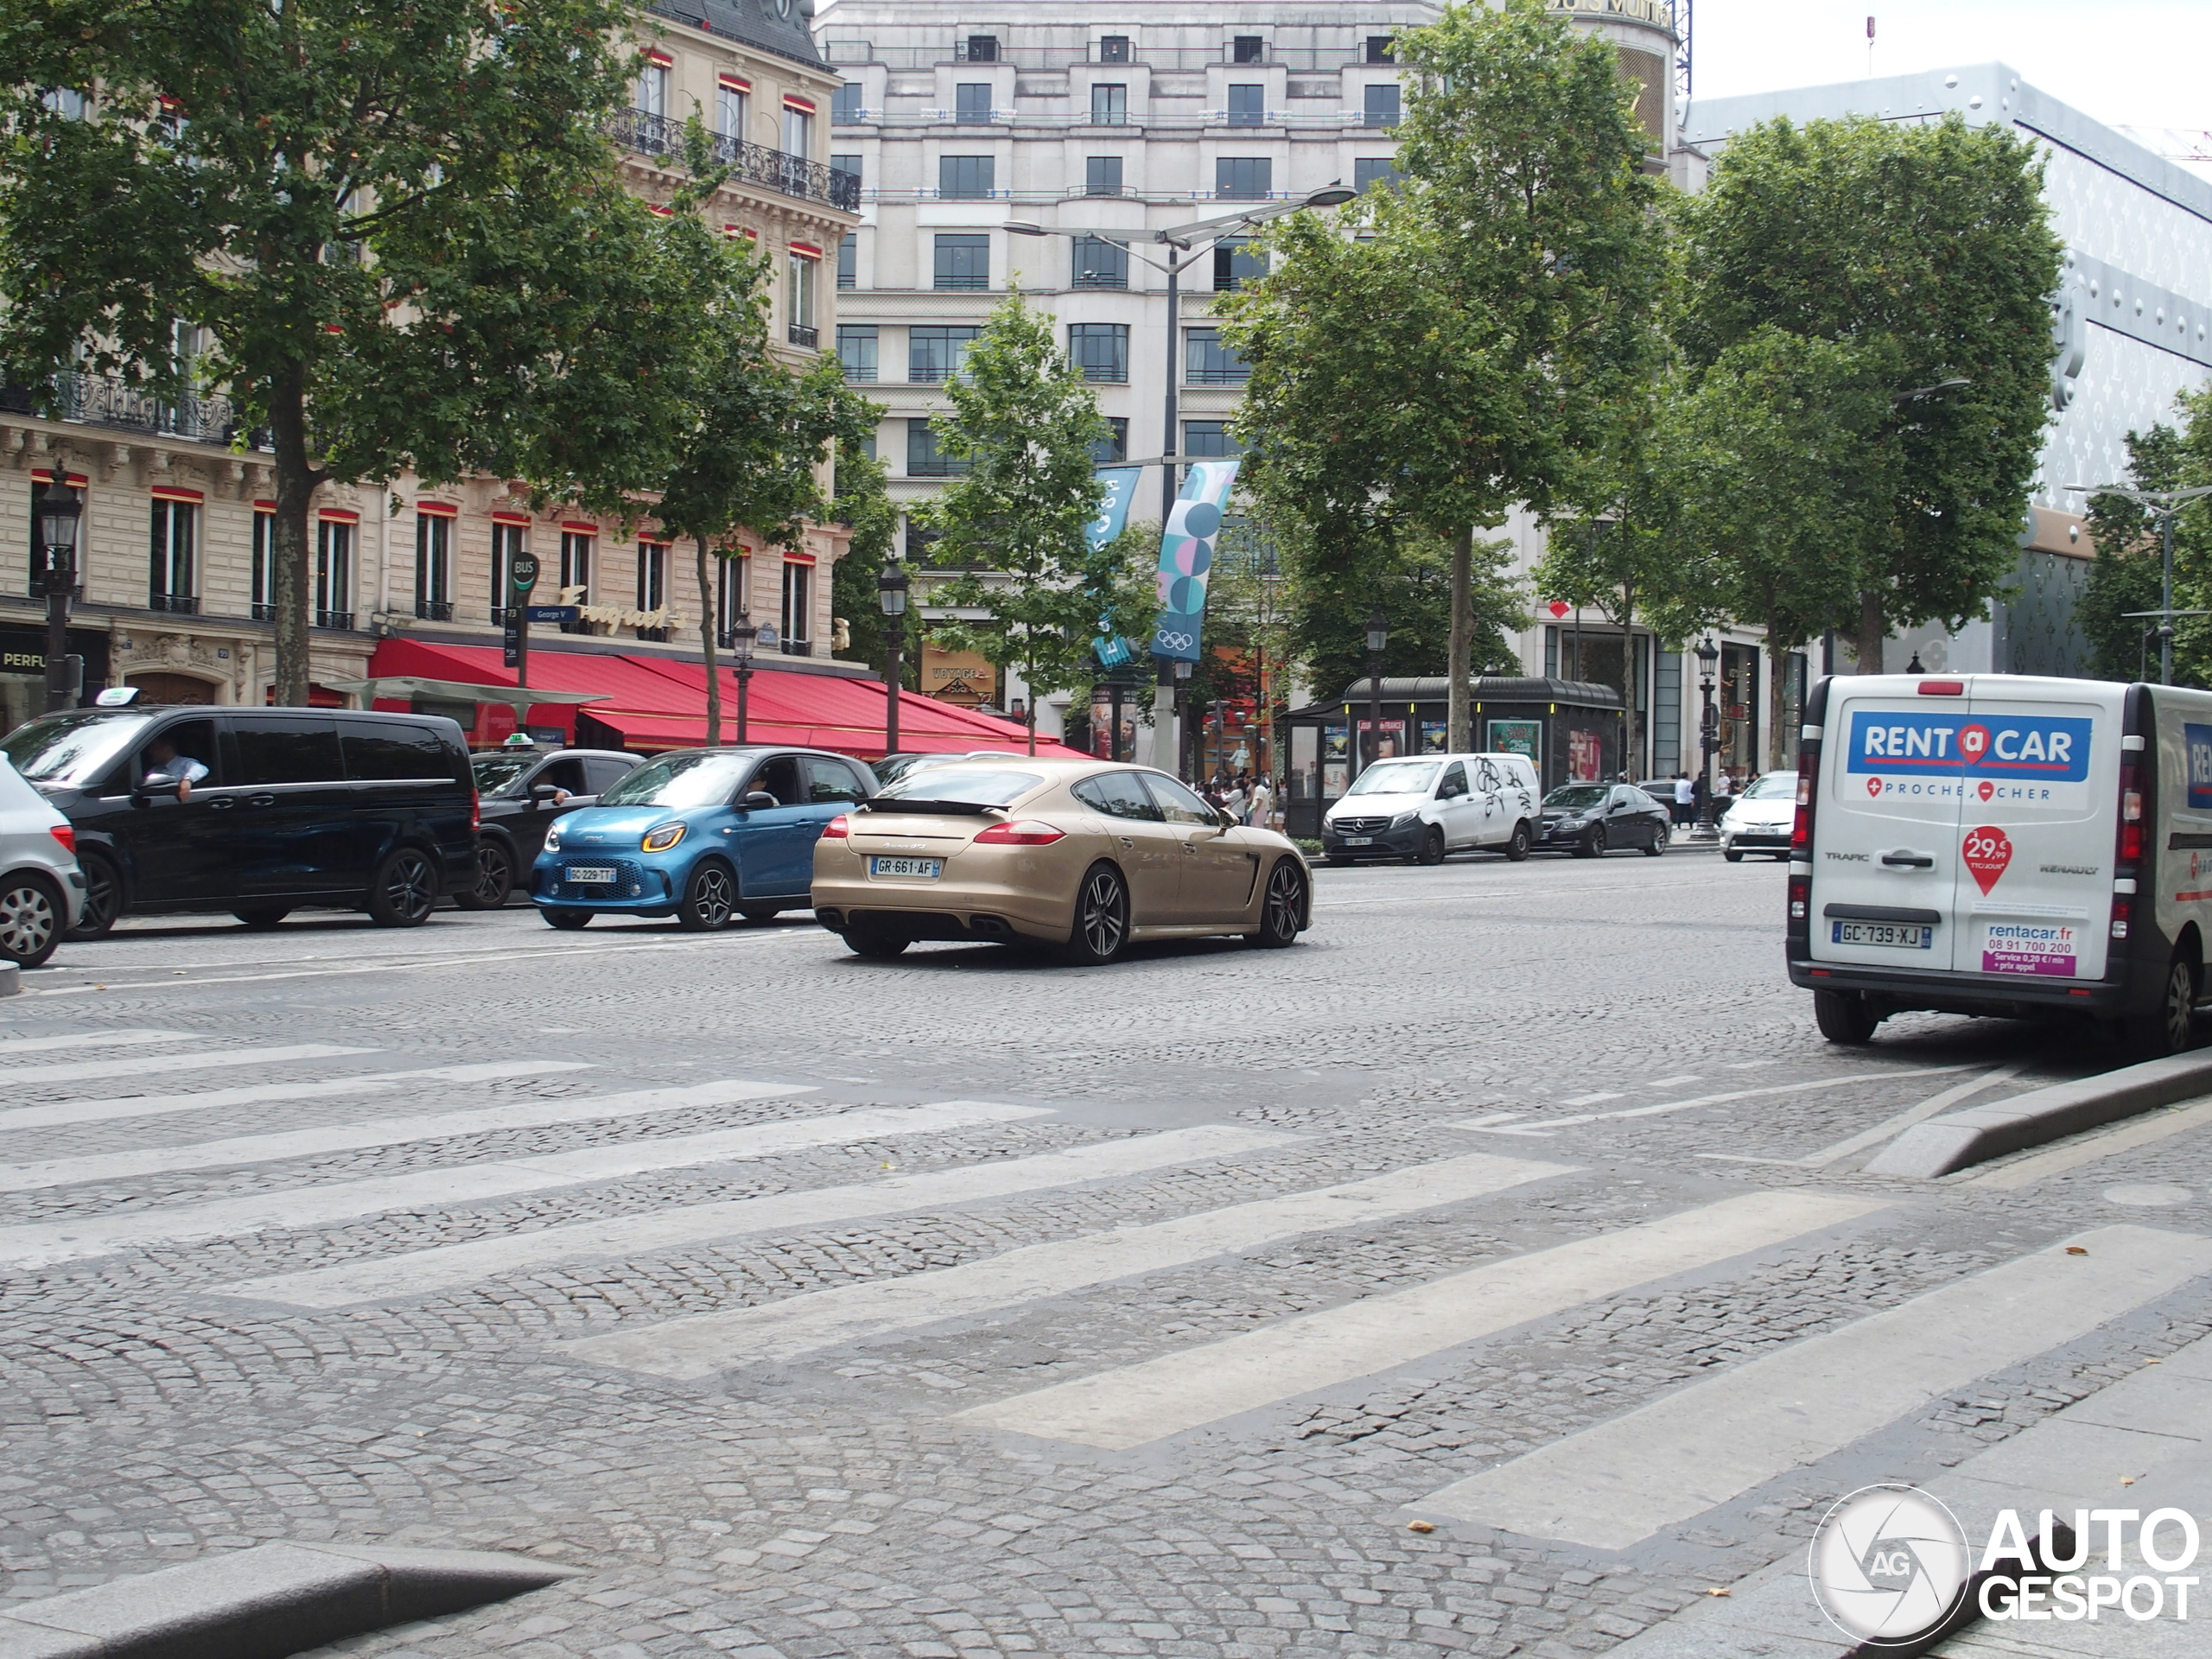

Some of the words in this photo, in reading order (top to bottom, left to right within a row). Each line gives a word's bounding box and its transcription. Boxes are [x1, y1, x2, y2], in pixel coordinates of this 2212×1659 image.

[515, 562, 533, 573] BUS
[507, 608, 517, 617] 73
[537, 610, 559, 620] George
[560, 585, 690, 636] Fuquet's
[1385, 721, 1402, 730] FRANCE
[1865, 726, 1955, 757] RENT
[1994, 729, 2072, 762] CAR
[1997, 787, 2050, 800] CHER
[1825, 852, 1870, 861] TRAFIC
[878, 860, 931, 874] GR-661-AF
[2039, 864, 2100, 875] RENAULT
[1843, 925, 1918, 944] GC-739-XJ
[1989, 925, 2073, 940] rentacar.fr
[1989, 939, 2003, 949] 08
[2006, 940, 2019, 950] 91
[2024, 941, 2045, 952] 700
[2050, 943, 2071, 953] 200
[1994, 952, 2022, 962] Service
[2023, 954, 2040, 963] 0,20
[1999, 962, 2014, 970] prix
[2015, 963, 2036, 973] appel
